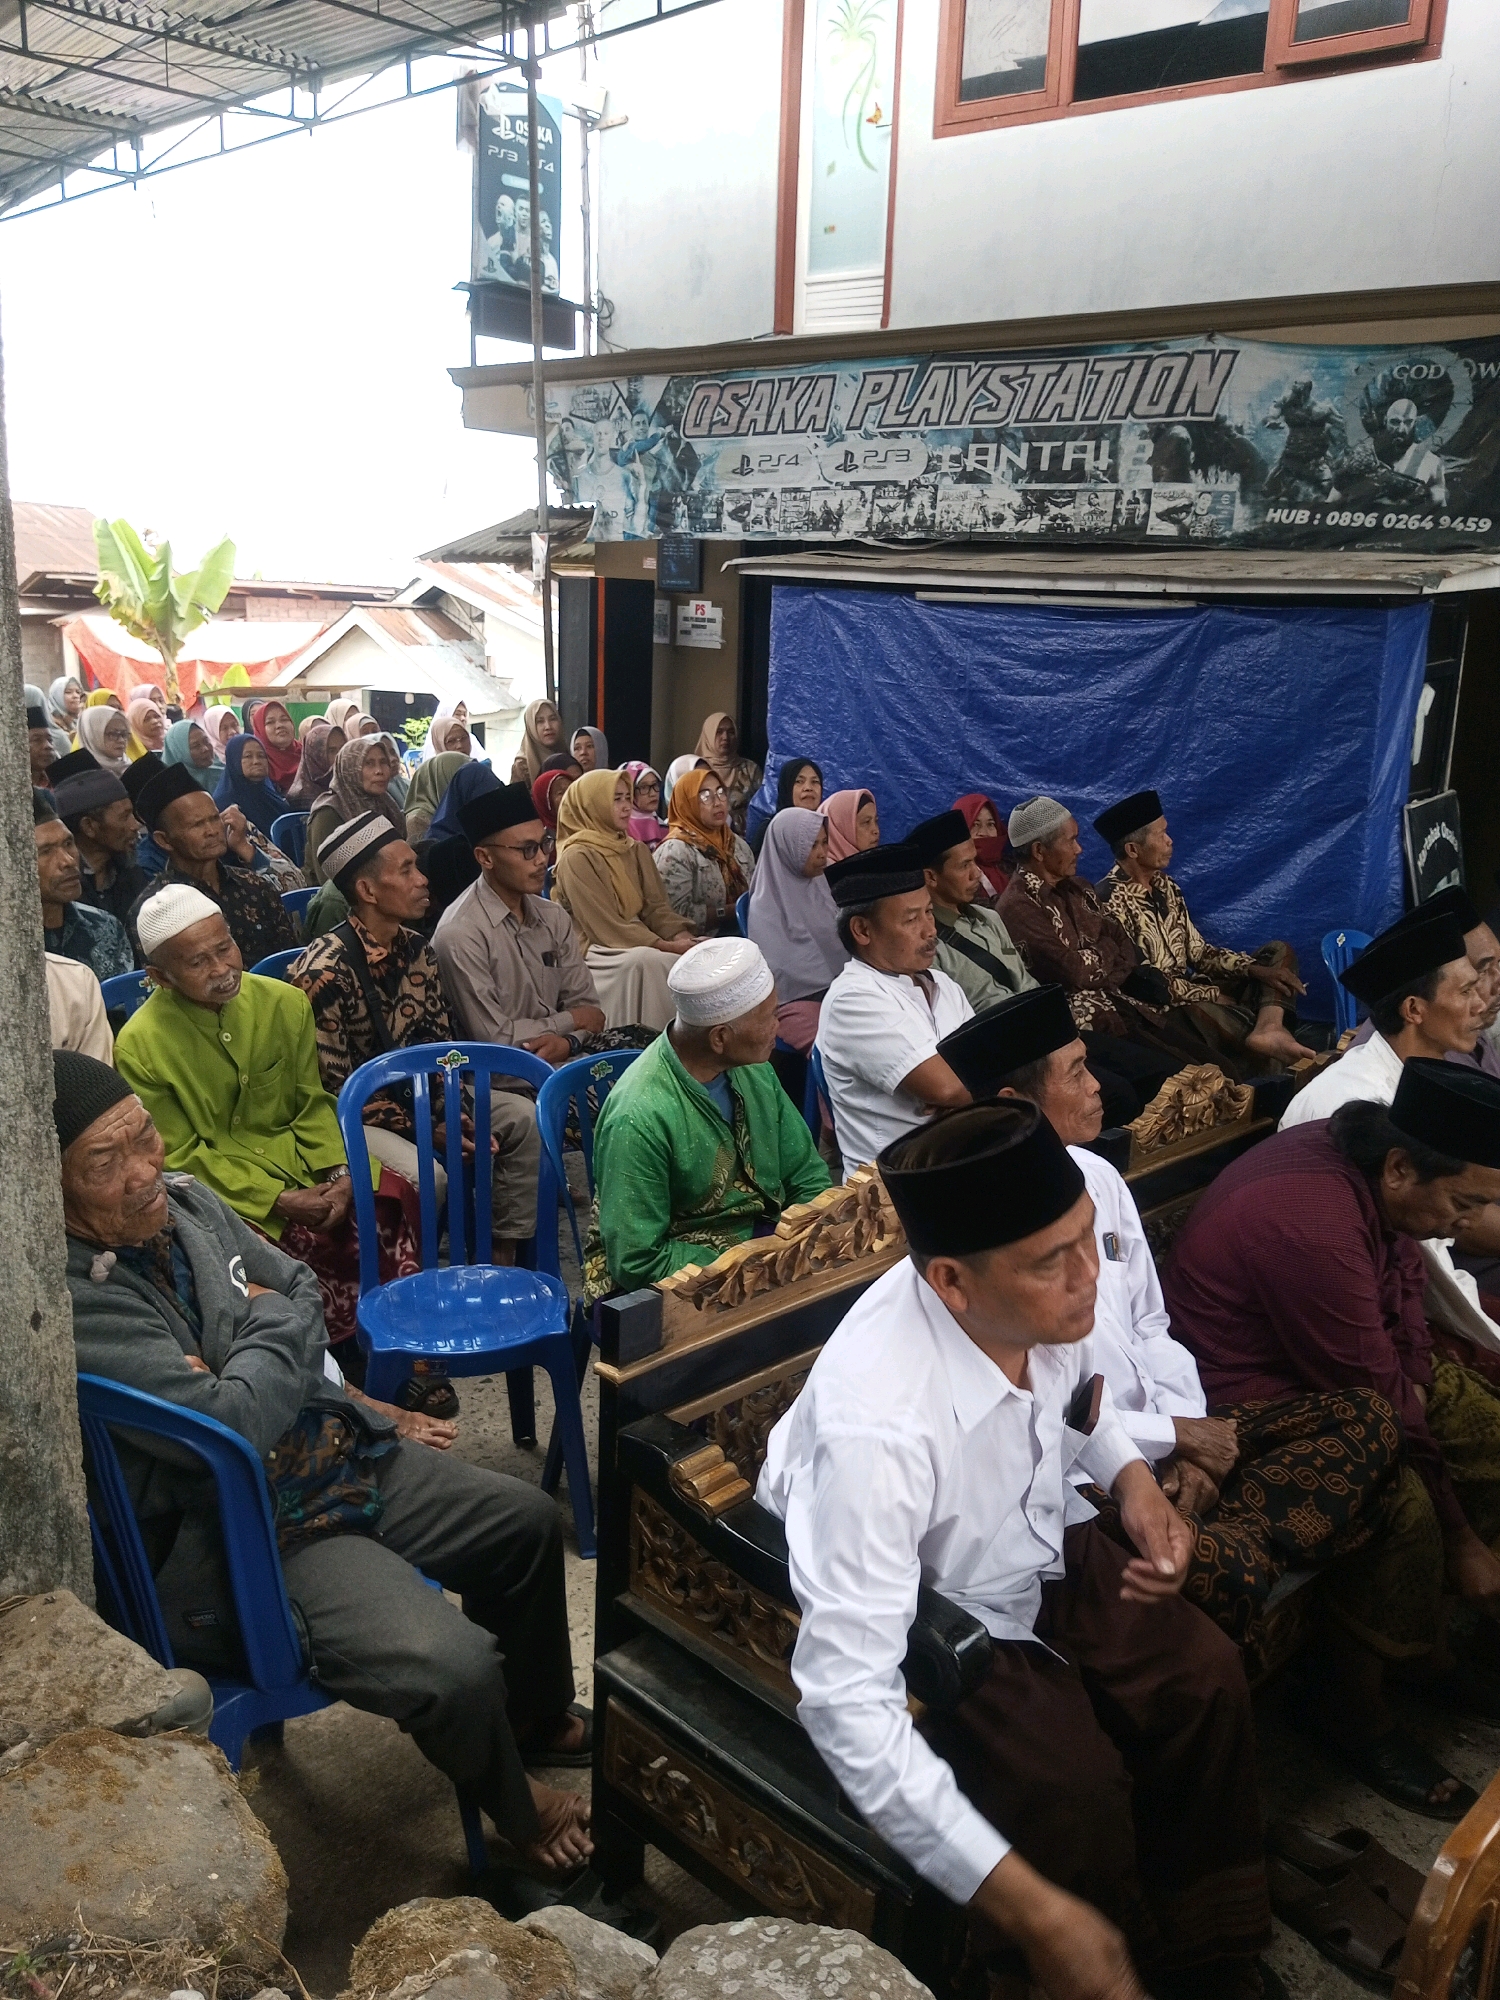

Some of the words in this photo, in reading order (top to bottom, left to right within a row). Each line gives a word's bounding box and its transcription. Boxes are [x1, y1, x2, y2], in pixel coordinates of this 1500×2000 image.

[515, 119, 554, 144] OSKA
[487, 144, 519, 163] PS3
[526, 155, 555, 173] S4
[1392, 364, 1445, 380] GOD
[681, 374, 837, 438] OSAKA
[846, 349, 1240, 434] PLAYSTATION
[758, 453, 801, 468] PS4
[862, 449, 911, 464] PS3
[1265, 508, 1310, 525] HUB
[1325, 511, 1379, 528] 0896
[1382, 513, 1434, 530] 0264
[1438, 515, 1493, 533] 9459
[694, 603, 706, 616] PS
